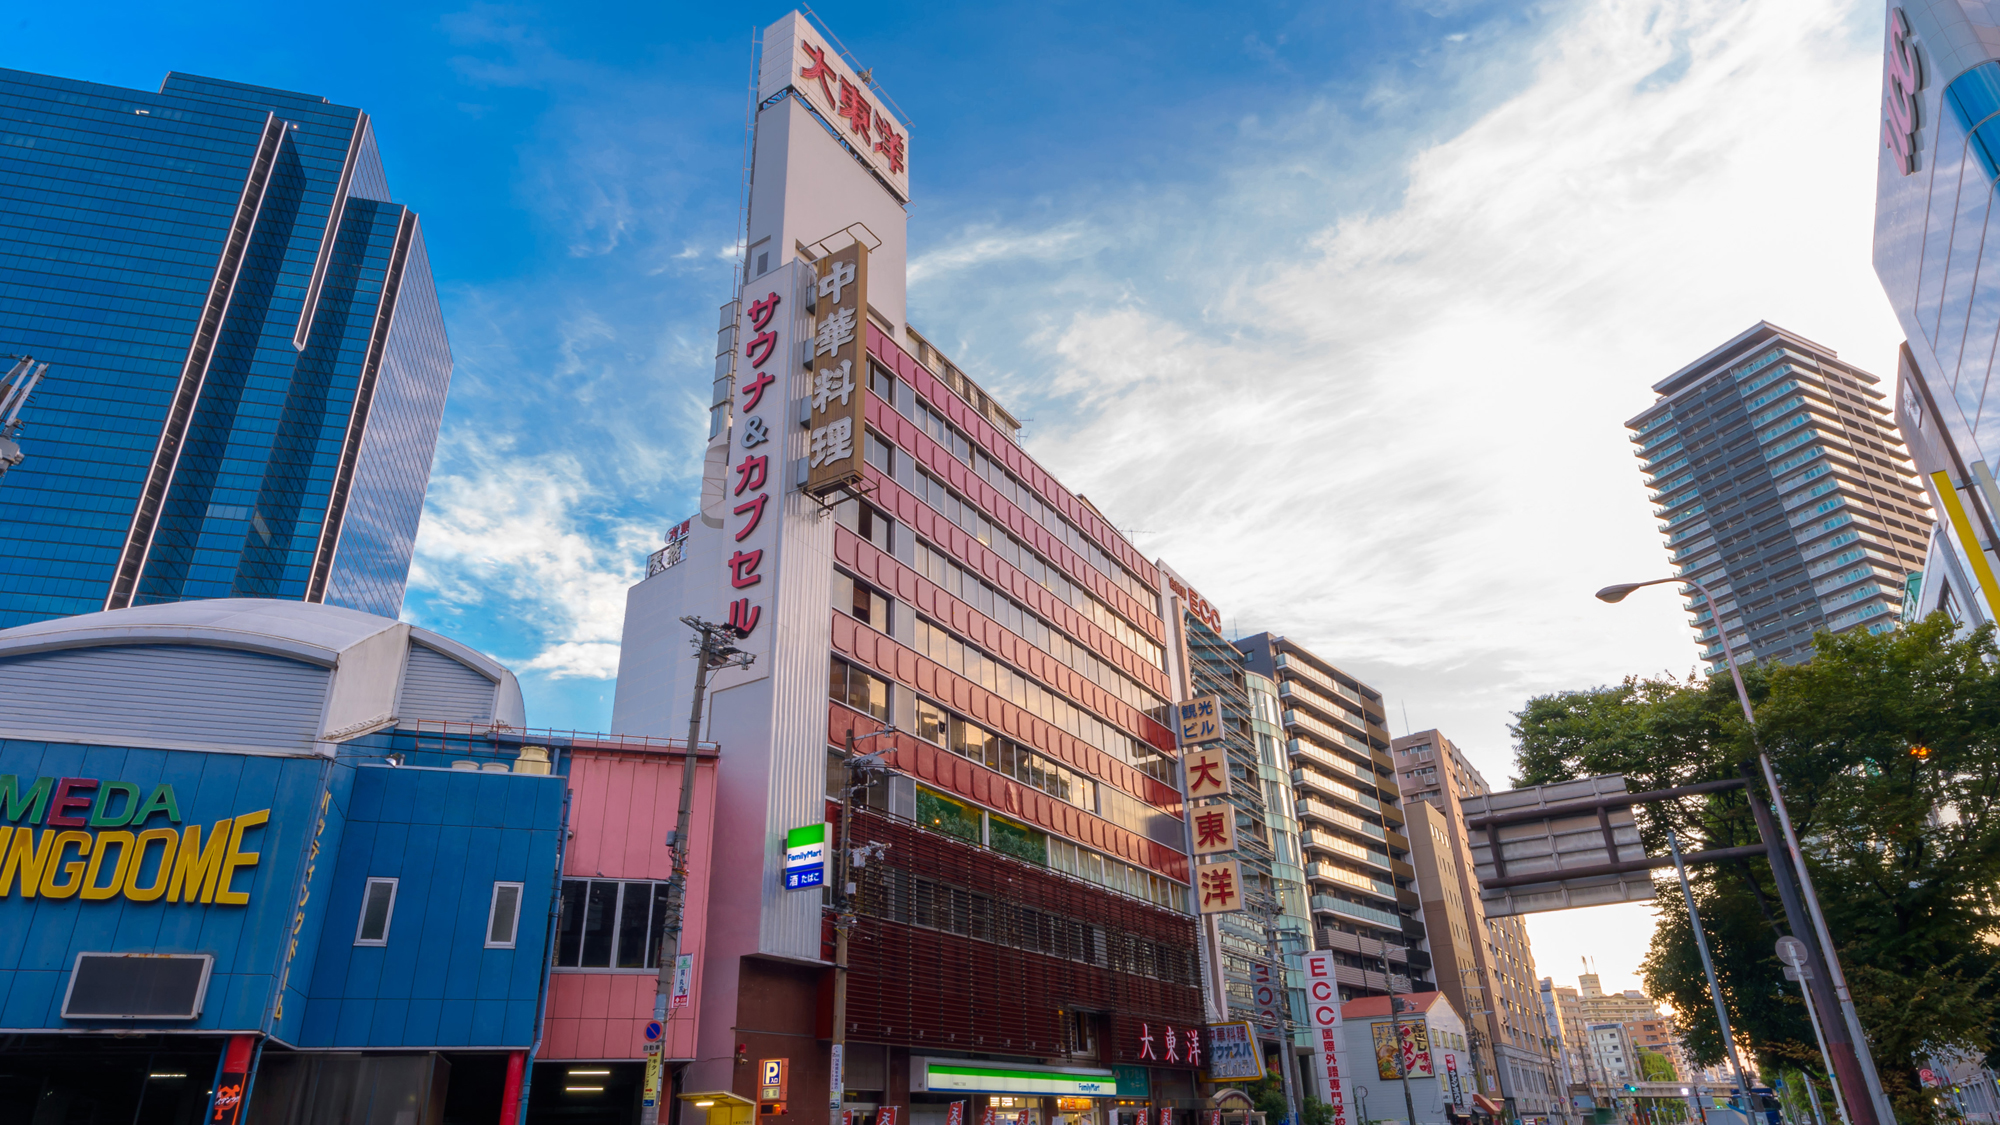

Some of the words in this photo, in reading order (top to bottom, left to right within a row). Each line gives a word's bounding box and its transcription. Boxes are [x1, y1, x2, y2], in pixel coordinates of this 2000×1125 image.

[800, 39, 905, 175] 大東洋
[810, 261, 857, 469] 中華料理
[728, 292, 780, 639] サウナ&カプセル
[649, 538, 688, 577] 天然
[1188, 587, 1221, 634] ECC
[1180, 699, 1214, 719] 観光
[1182, 718, 1215, 739] ビル
[1189, 756, 1235, 906] 大東洋
[787, 849, 822, 861] FamilyMart
[789, 874, 799, 887] 酒
[801, 872, 820, 884] たばこ
[1309, 957, 1335, 1025] ECC
[1139, 1023, 1201, 1067] 大東洋
[765, 1062, 779, 1084] P
[1078, 1083, 1100, 1094] FamilyMart
[1321, 1028, 1346, 1125] 国際外語専門学校
